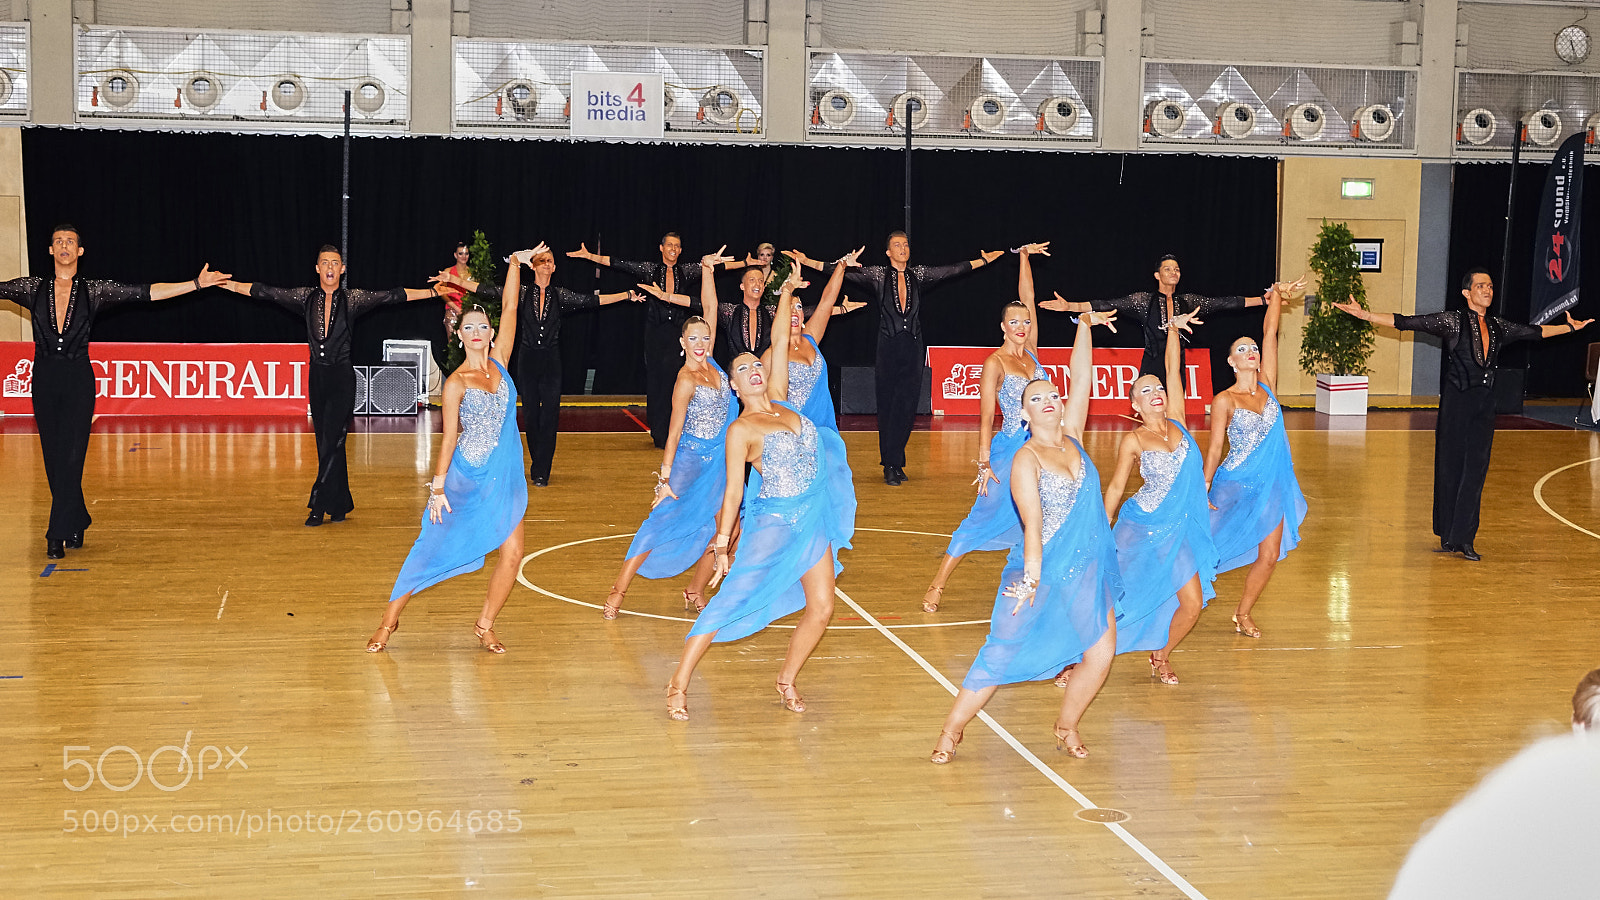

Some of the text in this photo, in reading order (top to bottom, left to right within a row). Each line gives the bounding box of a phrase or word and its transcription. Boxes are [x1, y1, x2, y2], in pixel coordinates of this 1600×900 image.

[588, 82, 646, 108] bits 4
[587, 105, 646, 121] media
[90, 360, 306, 399] GENERALI
